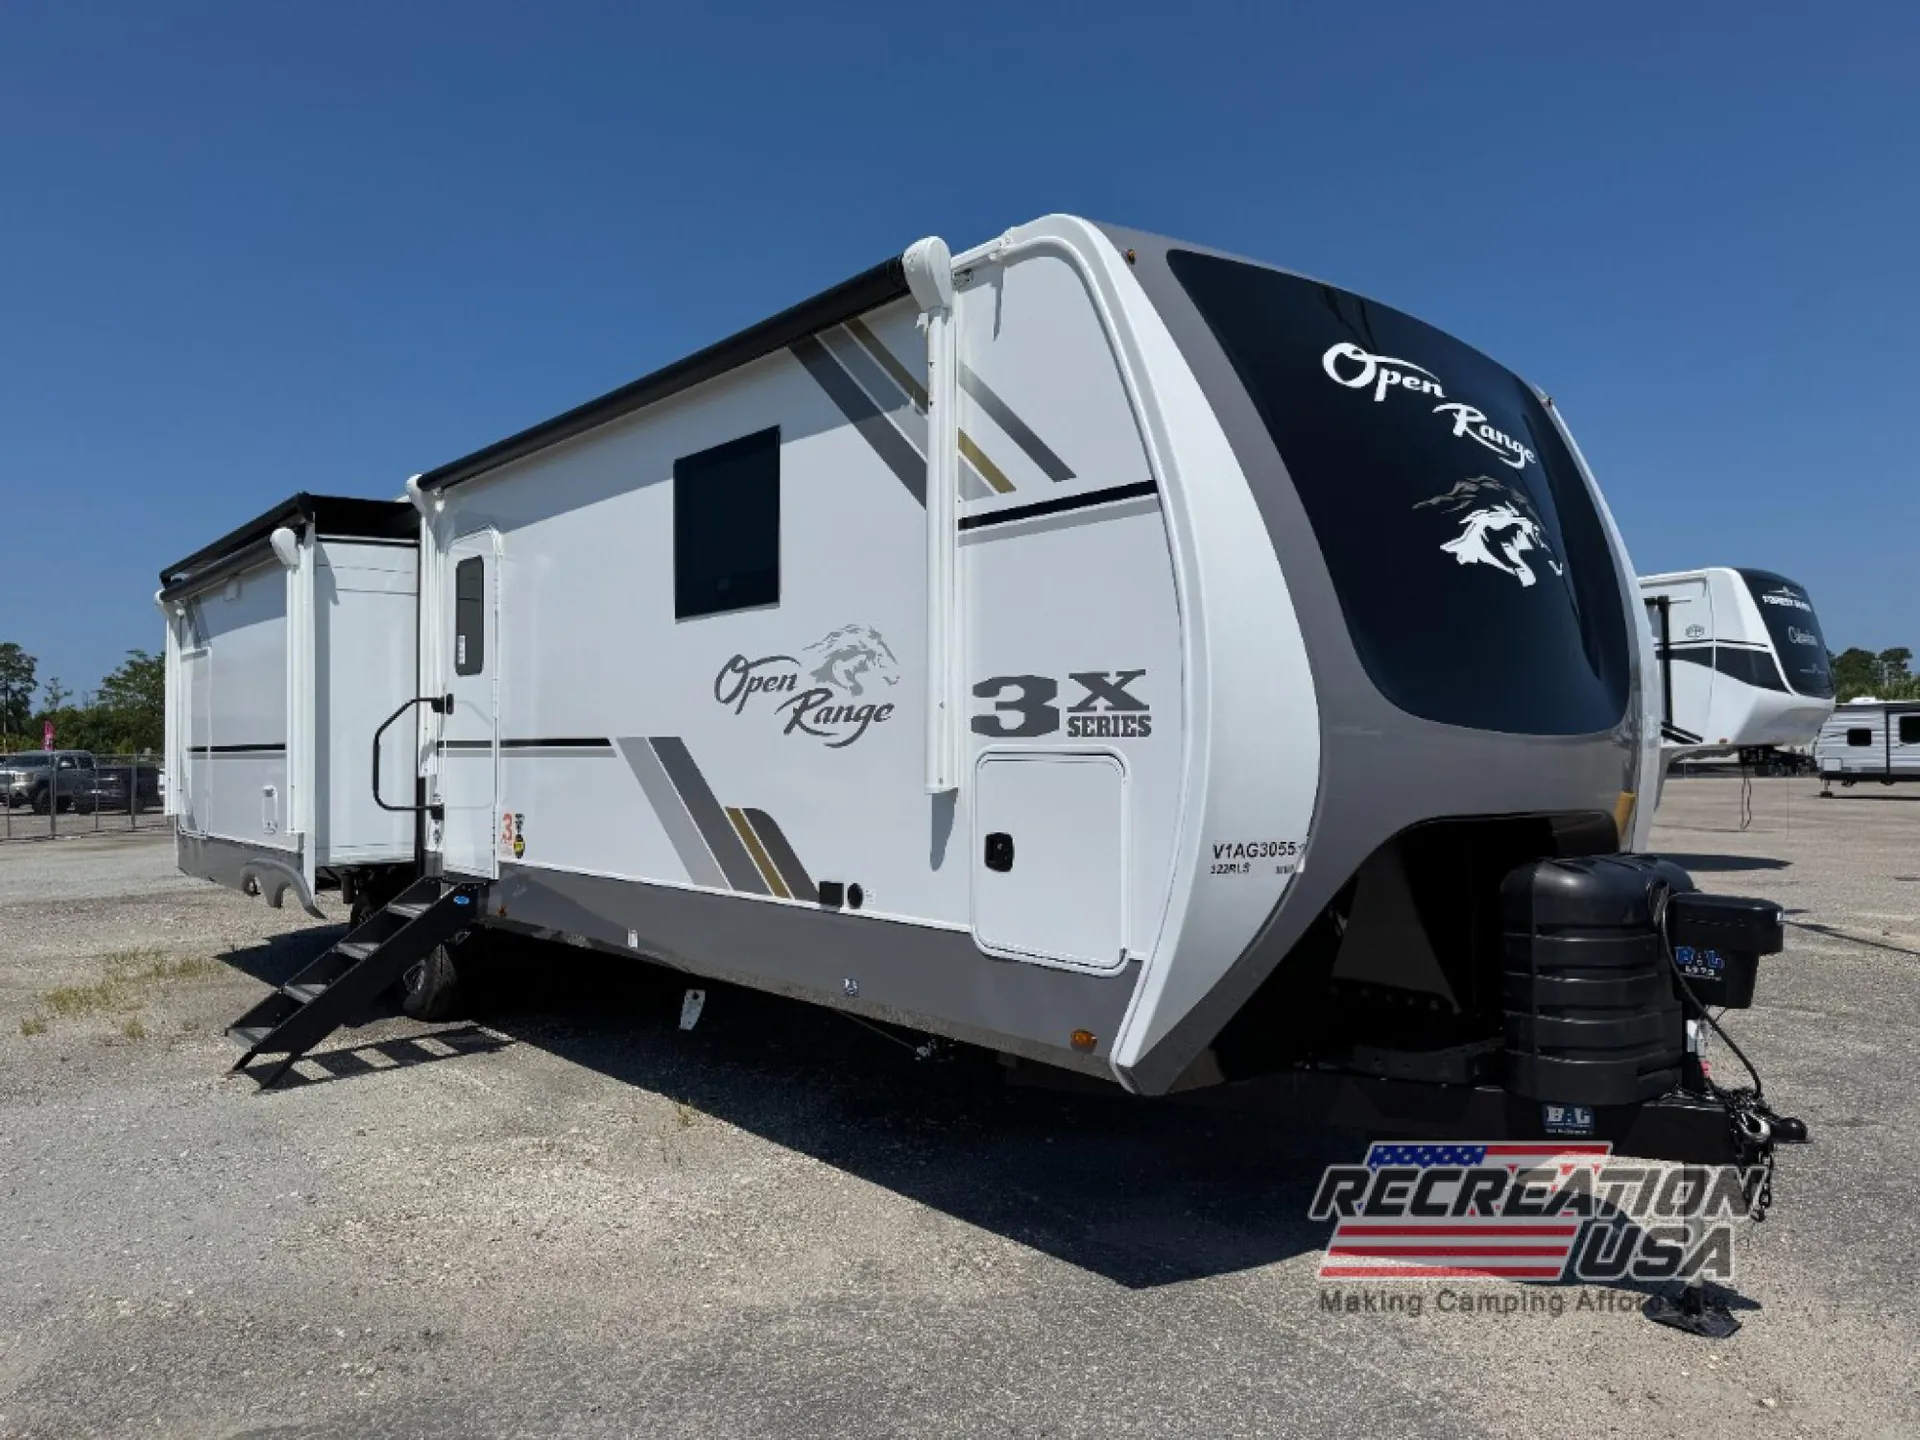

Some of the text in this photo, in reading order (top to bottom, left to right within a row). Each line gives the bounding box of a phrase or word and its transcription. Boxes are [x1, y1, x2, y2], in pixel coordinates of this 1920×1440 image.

[1322, 342, 1446, 401] Open
[1432, 403, 1536, 469] Range
[714, 654, 801, 715] Open
[774, 688, 895, 748] Range
[1067, 715, 1152, 738] SERIES
